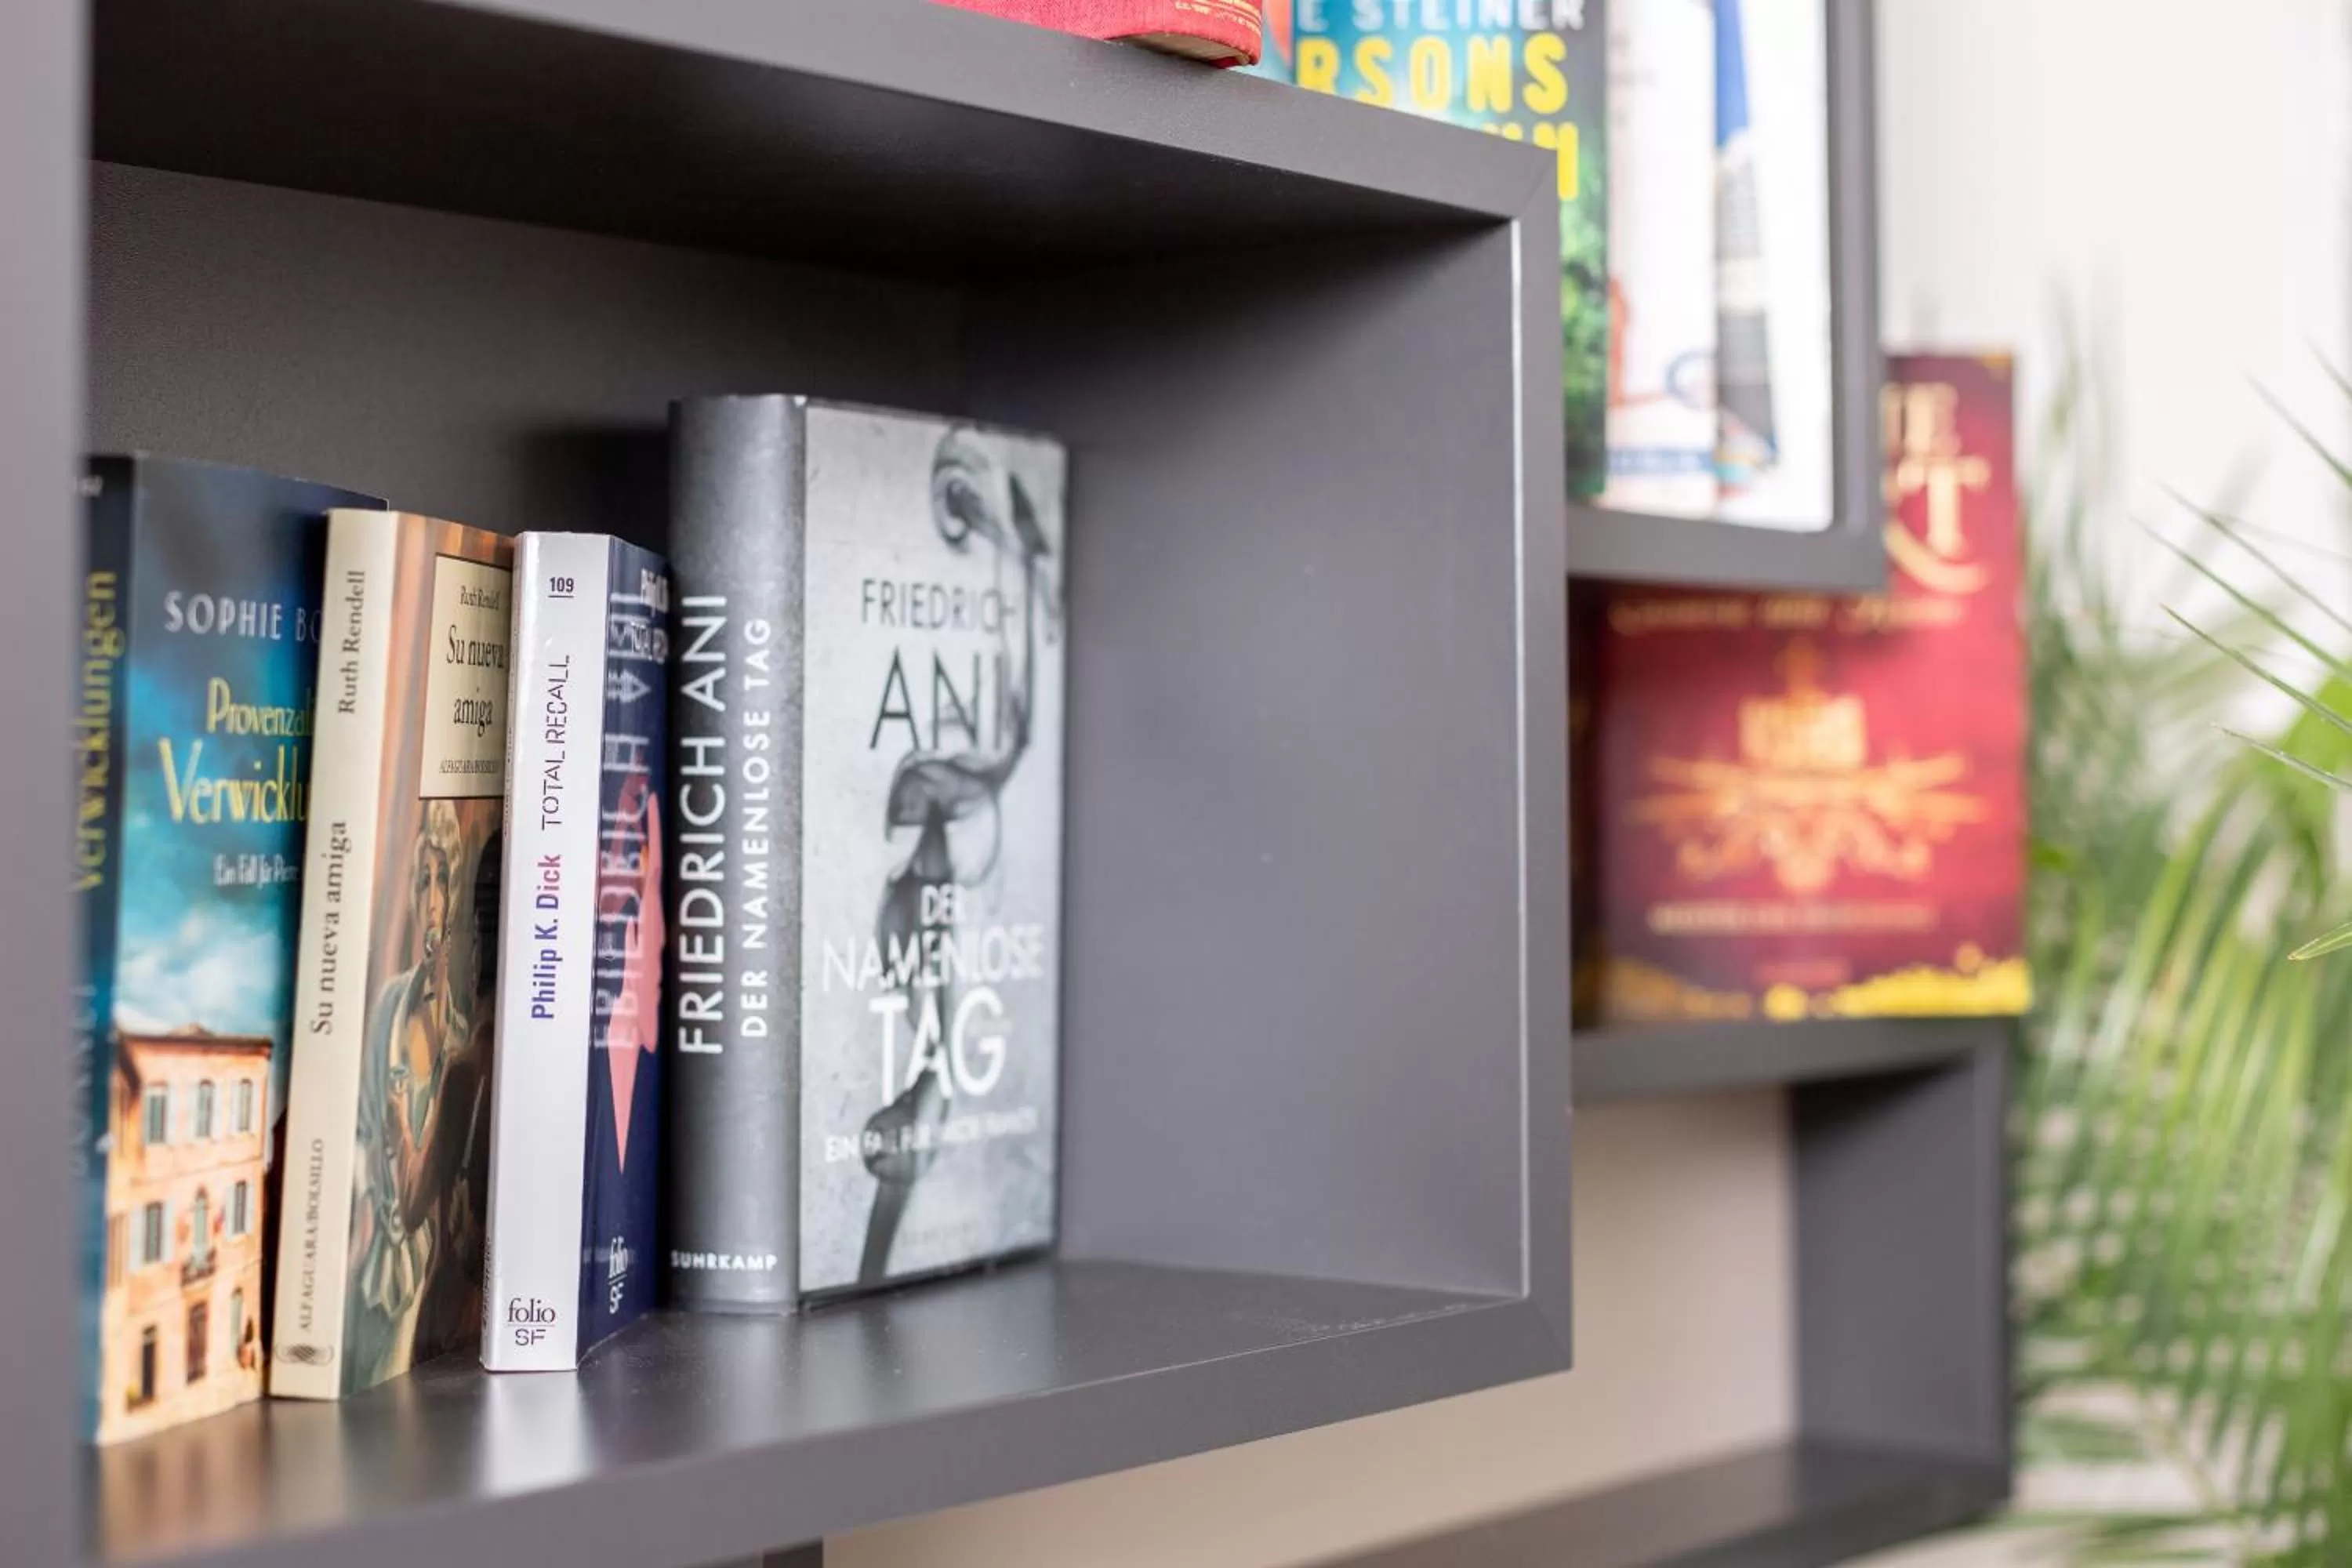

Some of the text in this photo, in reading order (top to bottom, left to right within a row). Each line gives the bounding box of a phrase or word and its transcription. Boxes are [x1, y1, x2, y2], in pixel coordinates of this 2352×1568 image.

[164, 590, 283, 641] SOPHIE
[550, 577, 574, 593] 109
[338, 570, 365, 714] Ruth Rendell
[446, 625, 504, 669] Su nueva
[454, 686, 493, 737] amiga
[869, 644, 1001, 750] ANI
[531, 655, 570, 1019] Philip K. Dick TOTAL RECALL
[678, 596, 728, 1054] FRIEDRICH ANI
[741, 619, 771, 1037] DER NAMENLOSE TAG
[311, 822, 351, 1035] Su nueva amiga
[822, 924, 1044, 993] NAMENLOSE
[868, 986, 1006, 1105] TAG
[671, 1250, 778, 1271] SUHRKAMP
[508, 1298, 556, 1323] folio
[515, 1328, 546, 1346] SF
